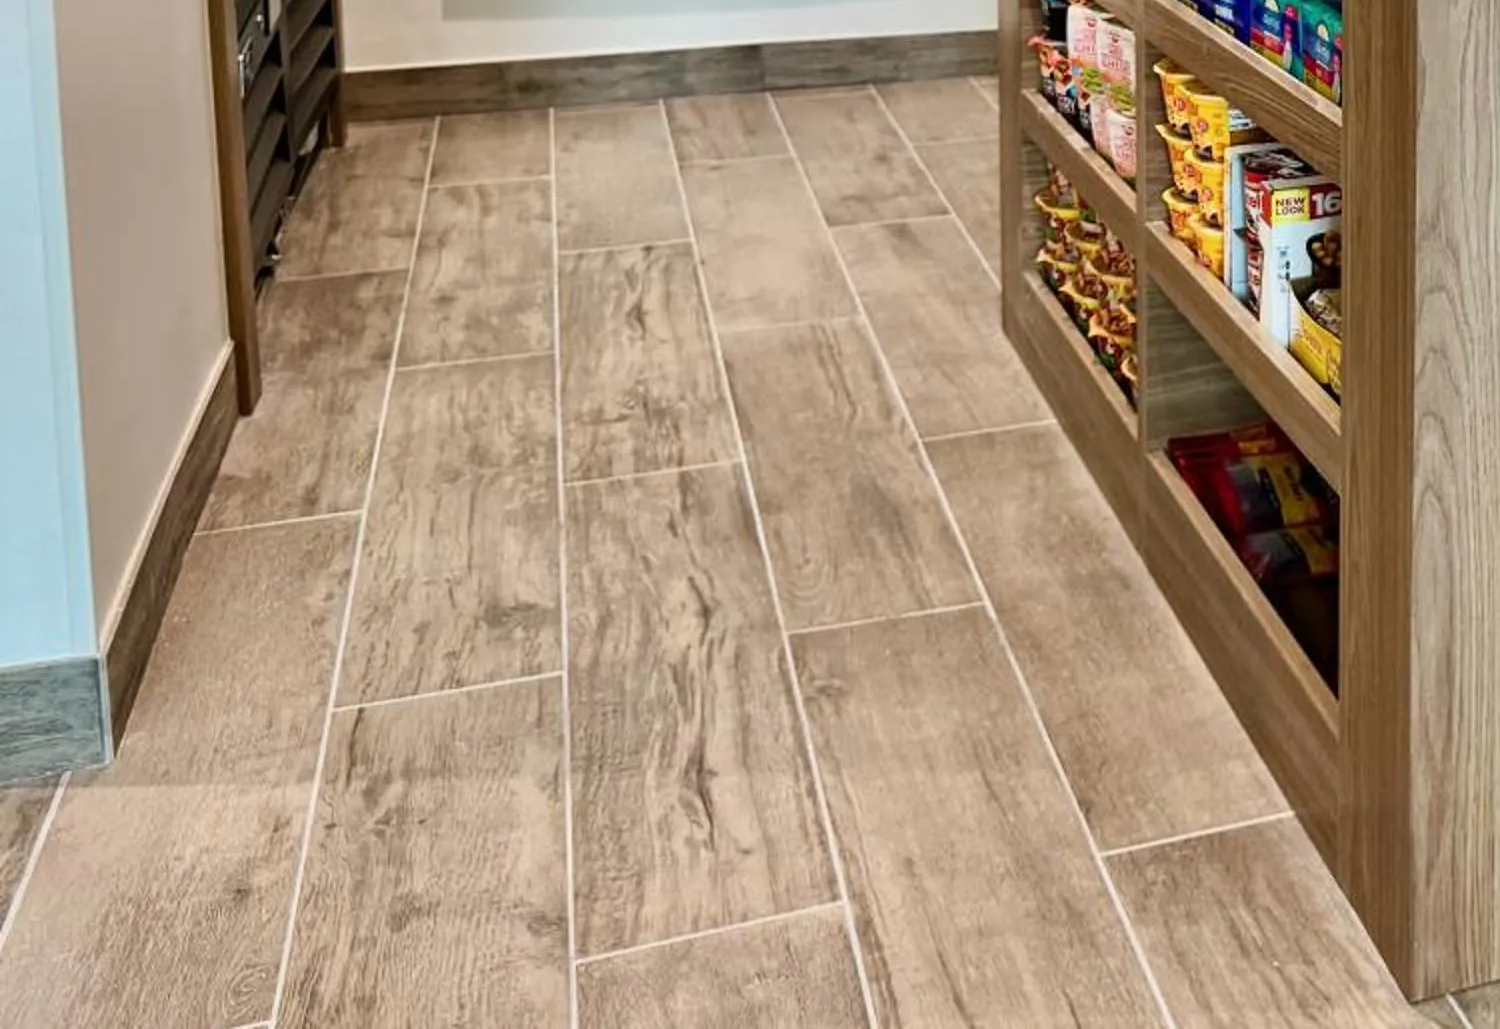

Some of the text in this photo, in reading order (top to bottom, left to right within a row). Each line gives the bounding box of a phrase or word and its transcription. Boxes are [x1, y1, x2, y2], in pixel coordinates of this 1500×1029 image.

[1275, 196, 1305, 208] NEW
[1311, 190, 1342, 217] 16
[1275, 206, 1305, 217] LOOK
